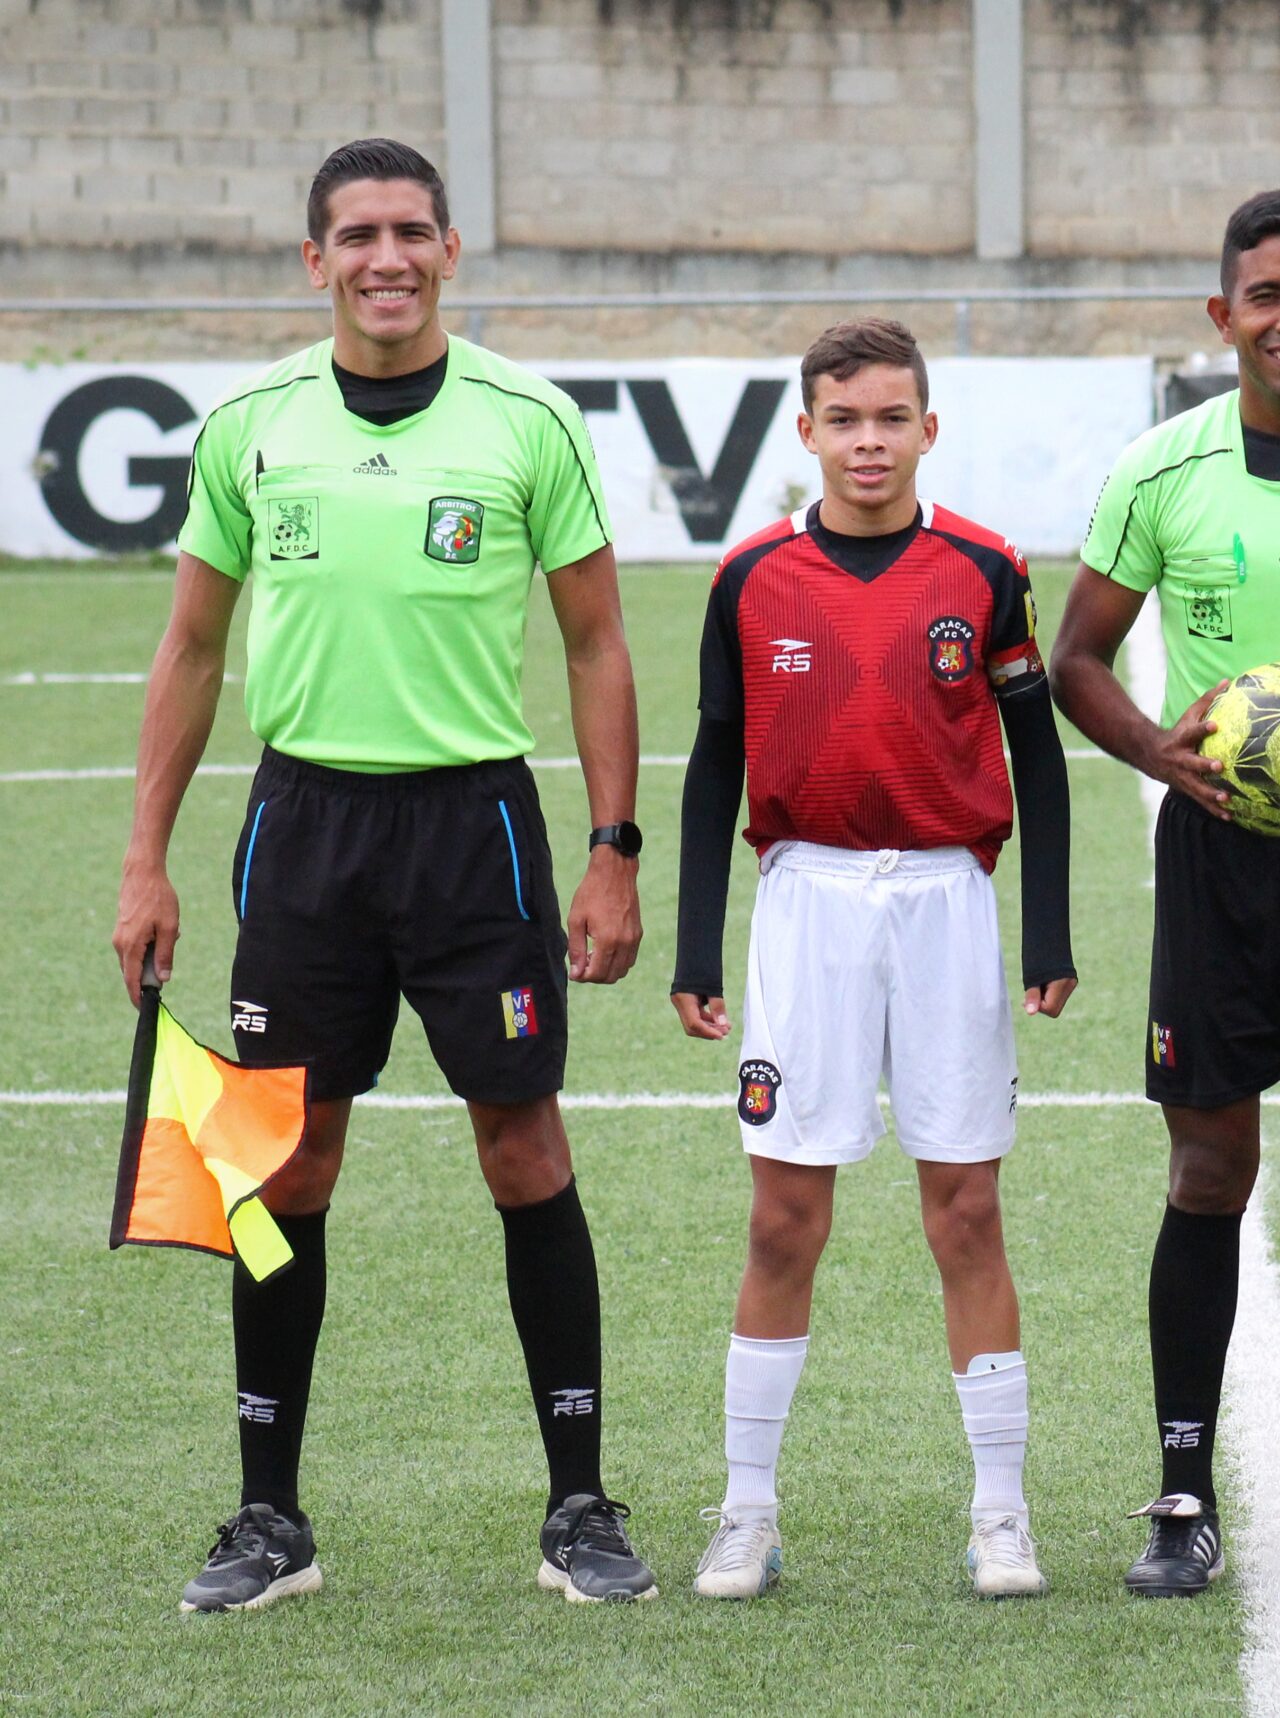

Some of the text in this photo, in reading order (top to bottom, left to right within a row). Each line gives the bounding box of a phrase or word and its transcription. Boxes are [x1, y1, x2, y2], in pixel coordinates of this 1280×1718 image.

[353, 465, 397, 476] adidas
[929, 620, 972, 639] CARACAS
[944, 631, 958, 639] FC
[772, 654, 811, 673] RS
[231, 1013, 267, 1033] RS
[741, 1064, 779, 1083] CARACAS
[751, 1072, 766, 1081] FC
